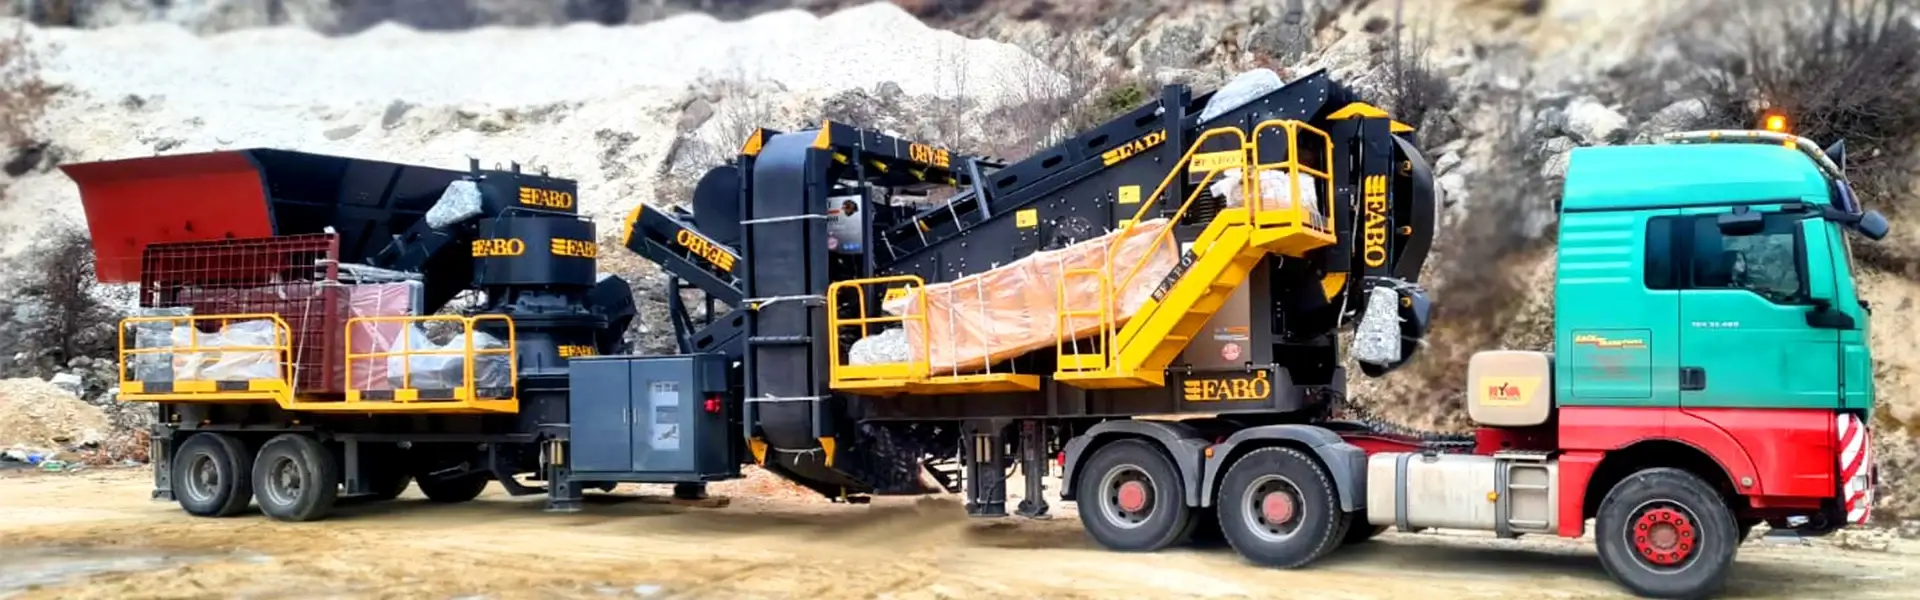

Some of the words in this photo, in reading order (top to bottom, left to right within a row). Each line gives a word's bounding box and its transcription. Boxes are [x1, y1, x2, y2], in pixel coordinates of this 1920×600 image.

[530, 188, 572, 208] FABO
[1364, 196, 1386, 267] FABO
[677, 229, 723, 265] FABO
[1201, 378, 1270, 400] FABO
